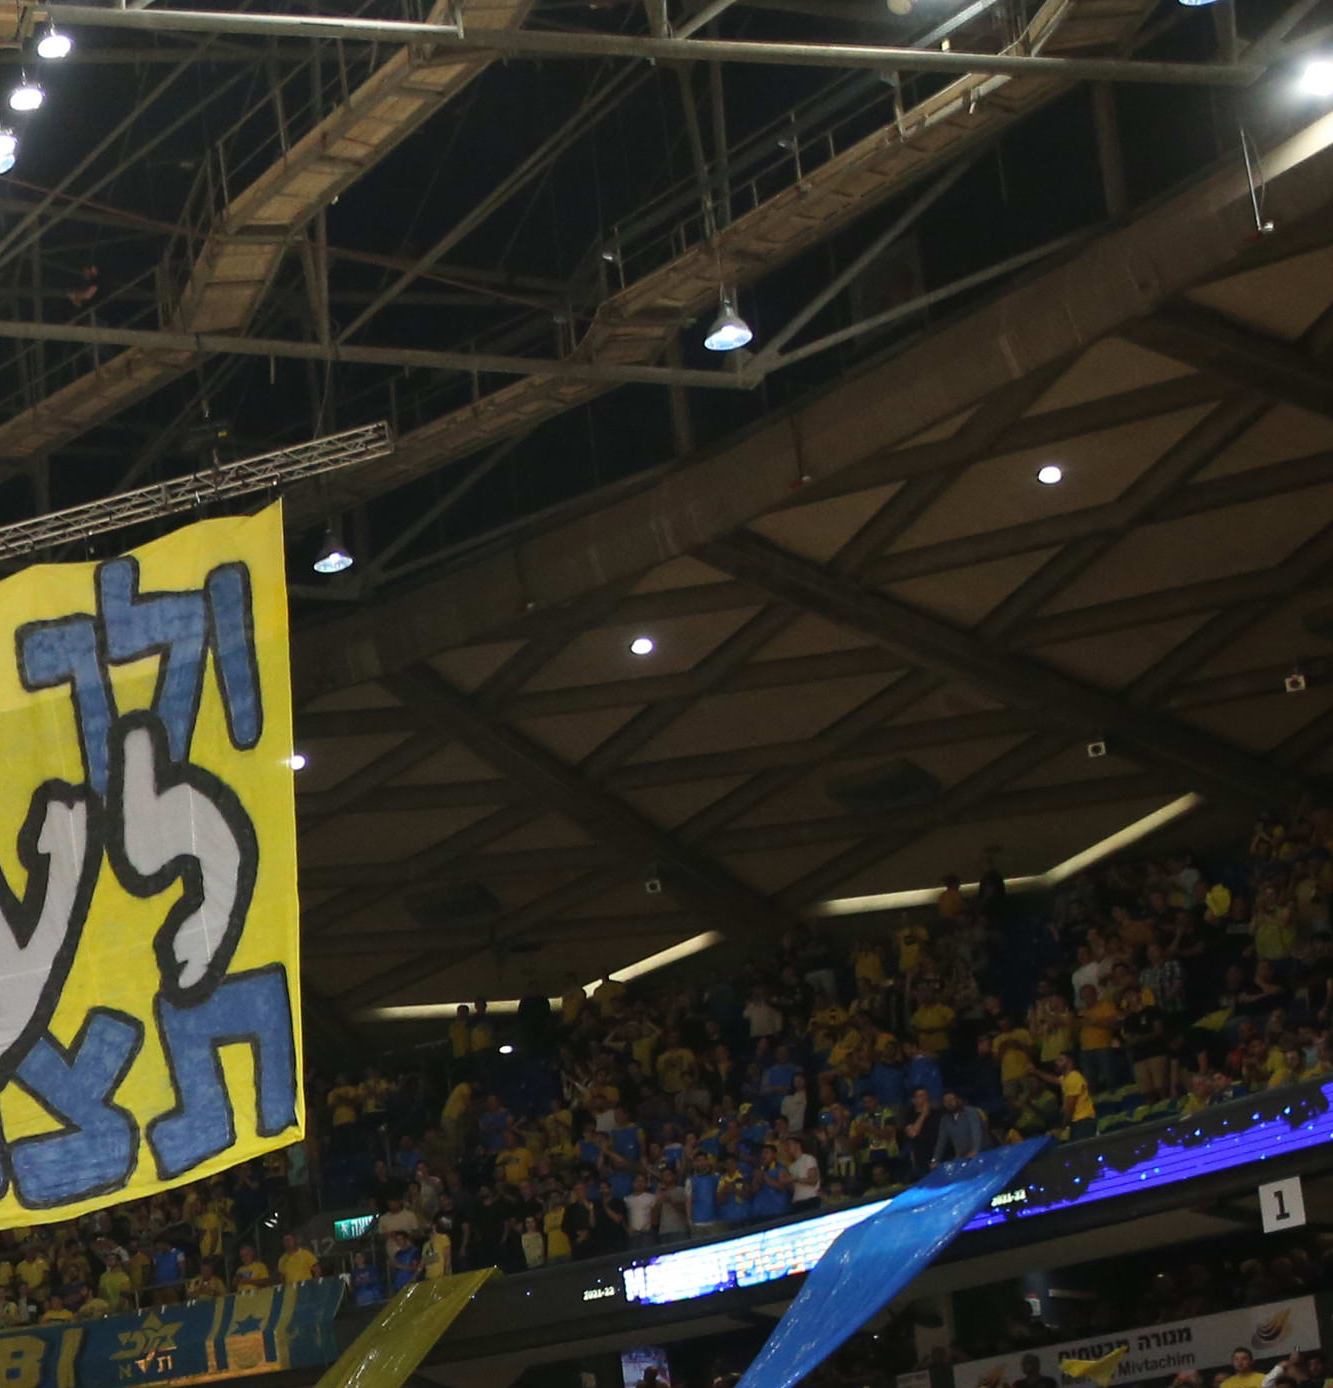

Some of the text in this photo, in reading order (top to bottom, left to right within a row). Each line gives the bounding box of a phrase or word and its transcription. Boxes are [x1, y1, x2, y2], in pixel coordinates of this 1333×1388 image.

[15, 555, 265, 800] ולך
[1272, 1190, 1291, 1220] 1
[1137, 1326, 1193, 1351] מנורה
